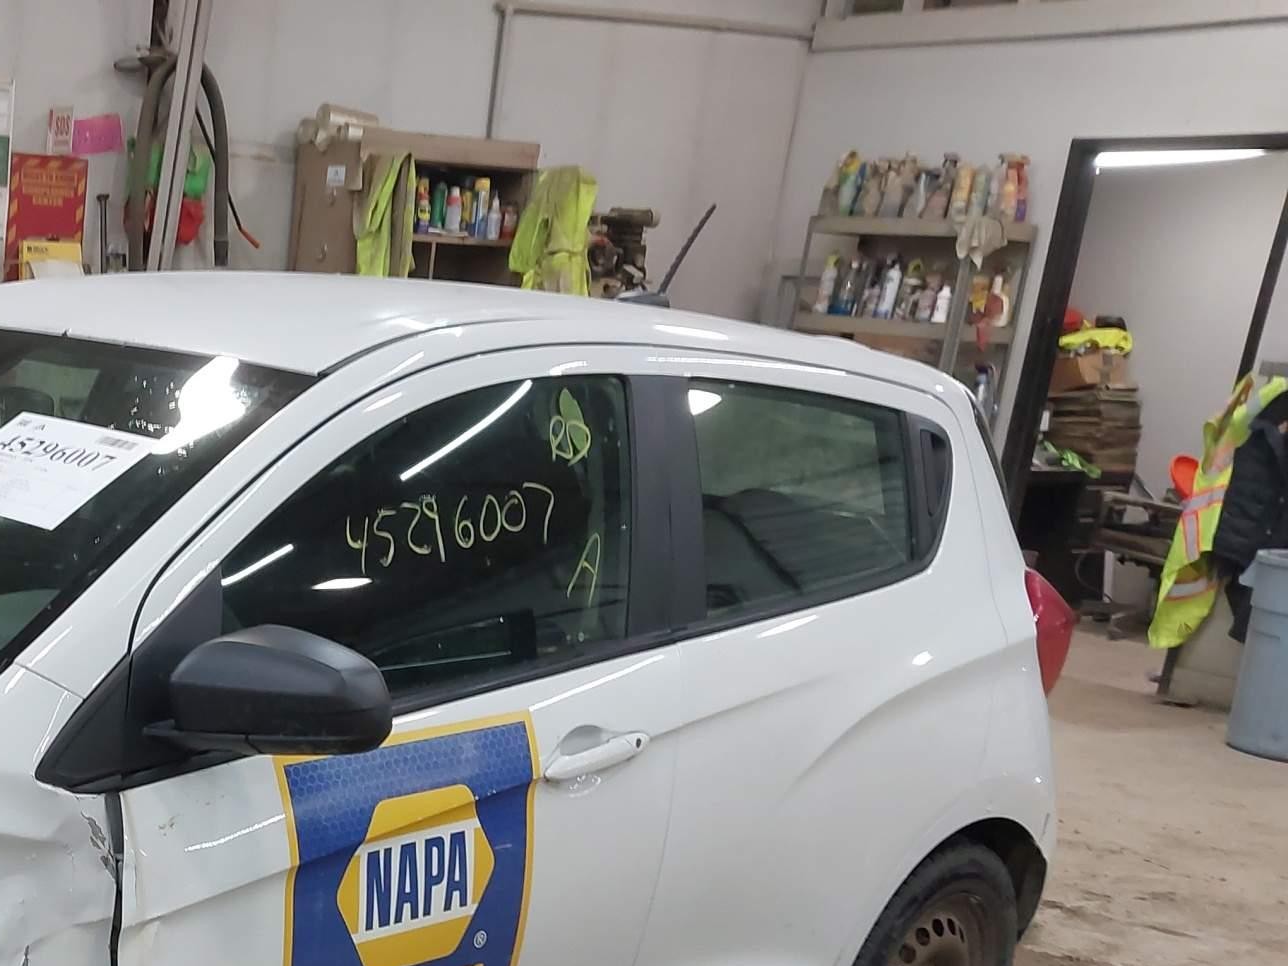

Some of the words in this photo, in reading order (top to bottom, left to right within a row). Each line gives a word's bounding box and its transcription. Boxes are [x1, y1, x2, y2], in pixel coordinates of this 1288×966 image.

[0, 435, 116, 471] 45296007
[345, 481, 555, 575] 45296007
[364, 830, 469, 932] NAPA
